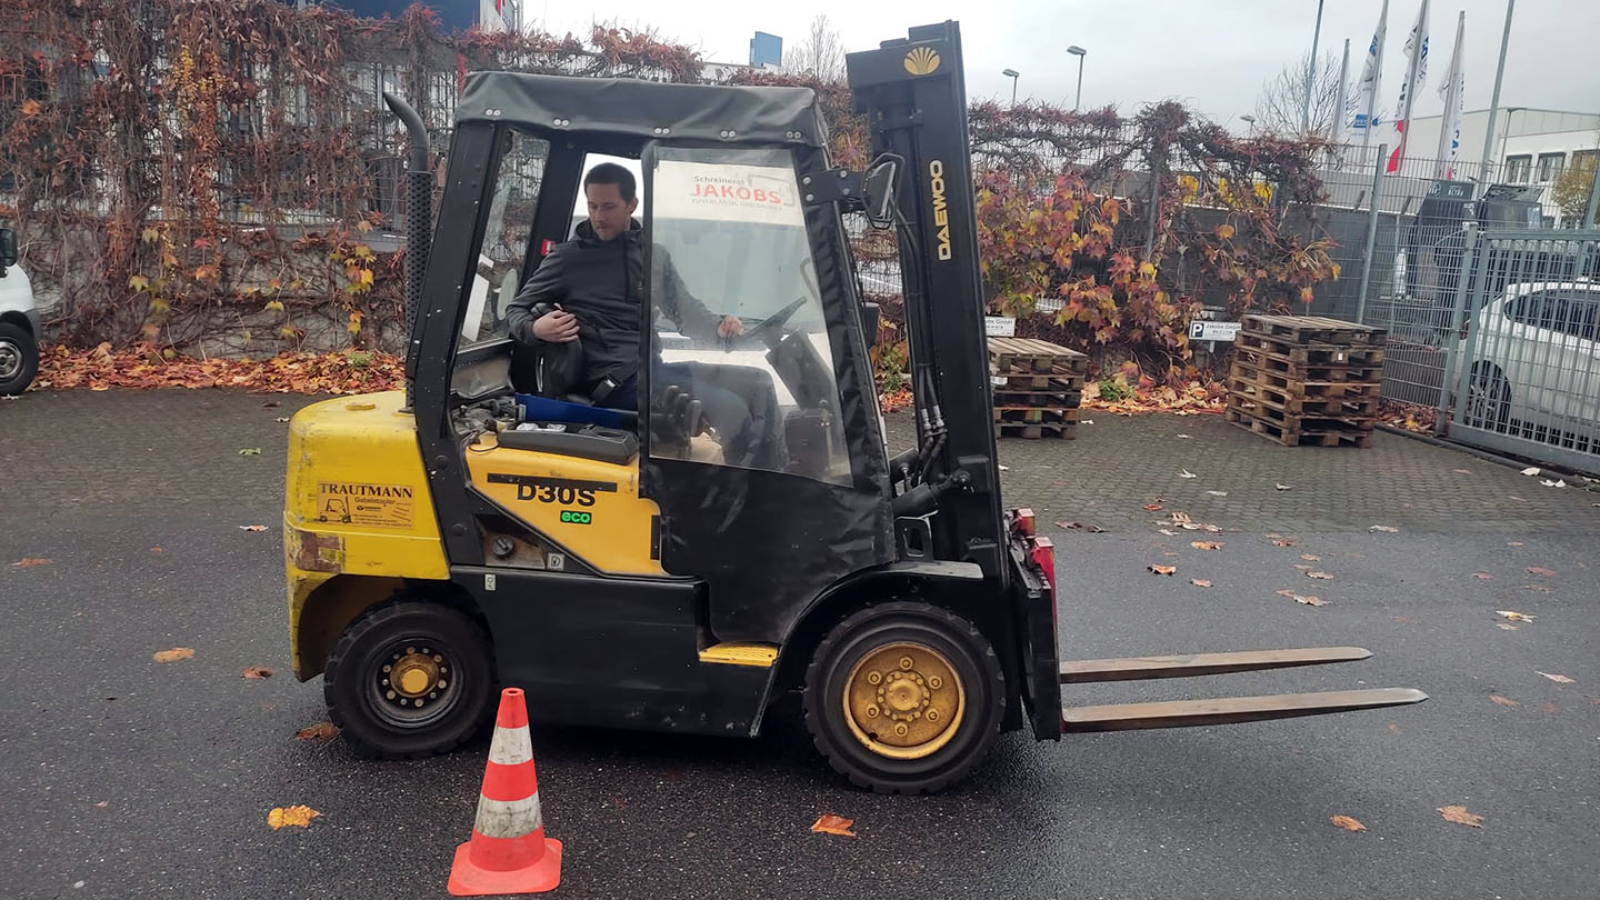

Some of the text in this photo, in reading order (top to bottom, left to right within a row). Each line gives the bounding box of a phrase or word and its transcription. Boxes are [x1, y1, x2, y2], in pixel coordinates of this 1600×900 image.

[689, 183, 782, 204] JAKOBS
[929, 159, 952, 261] DAEWOO
[1191, 323, 1203, 337] P
[320, 483, 413, 499] TRAUTMANN
[517, 481, 596, 507] D30S
[561, 511, 591, 524] eco
